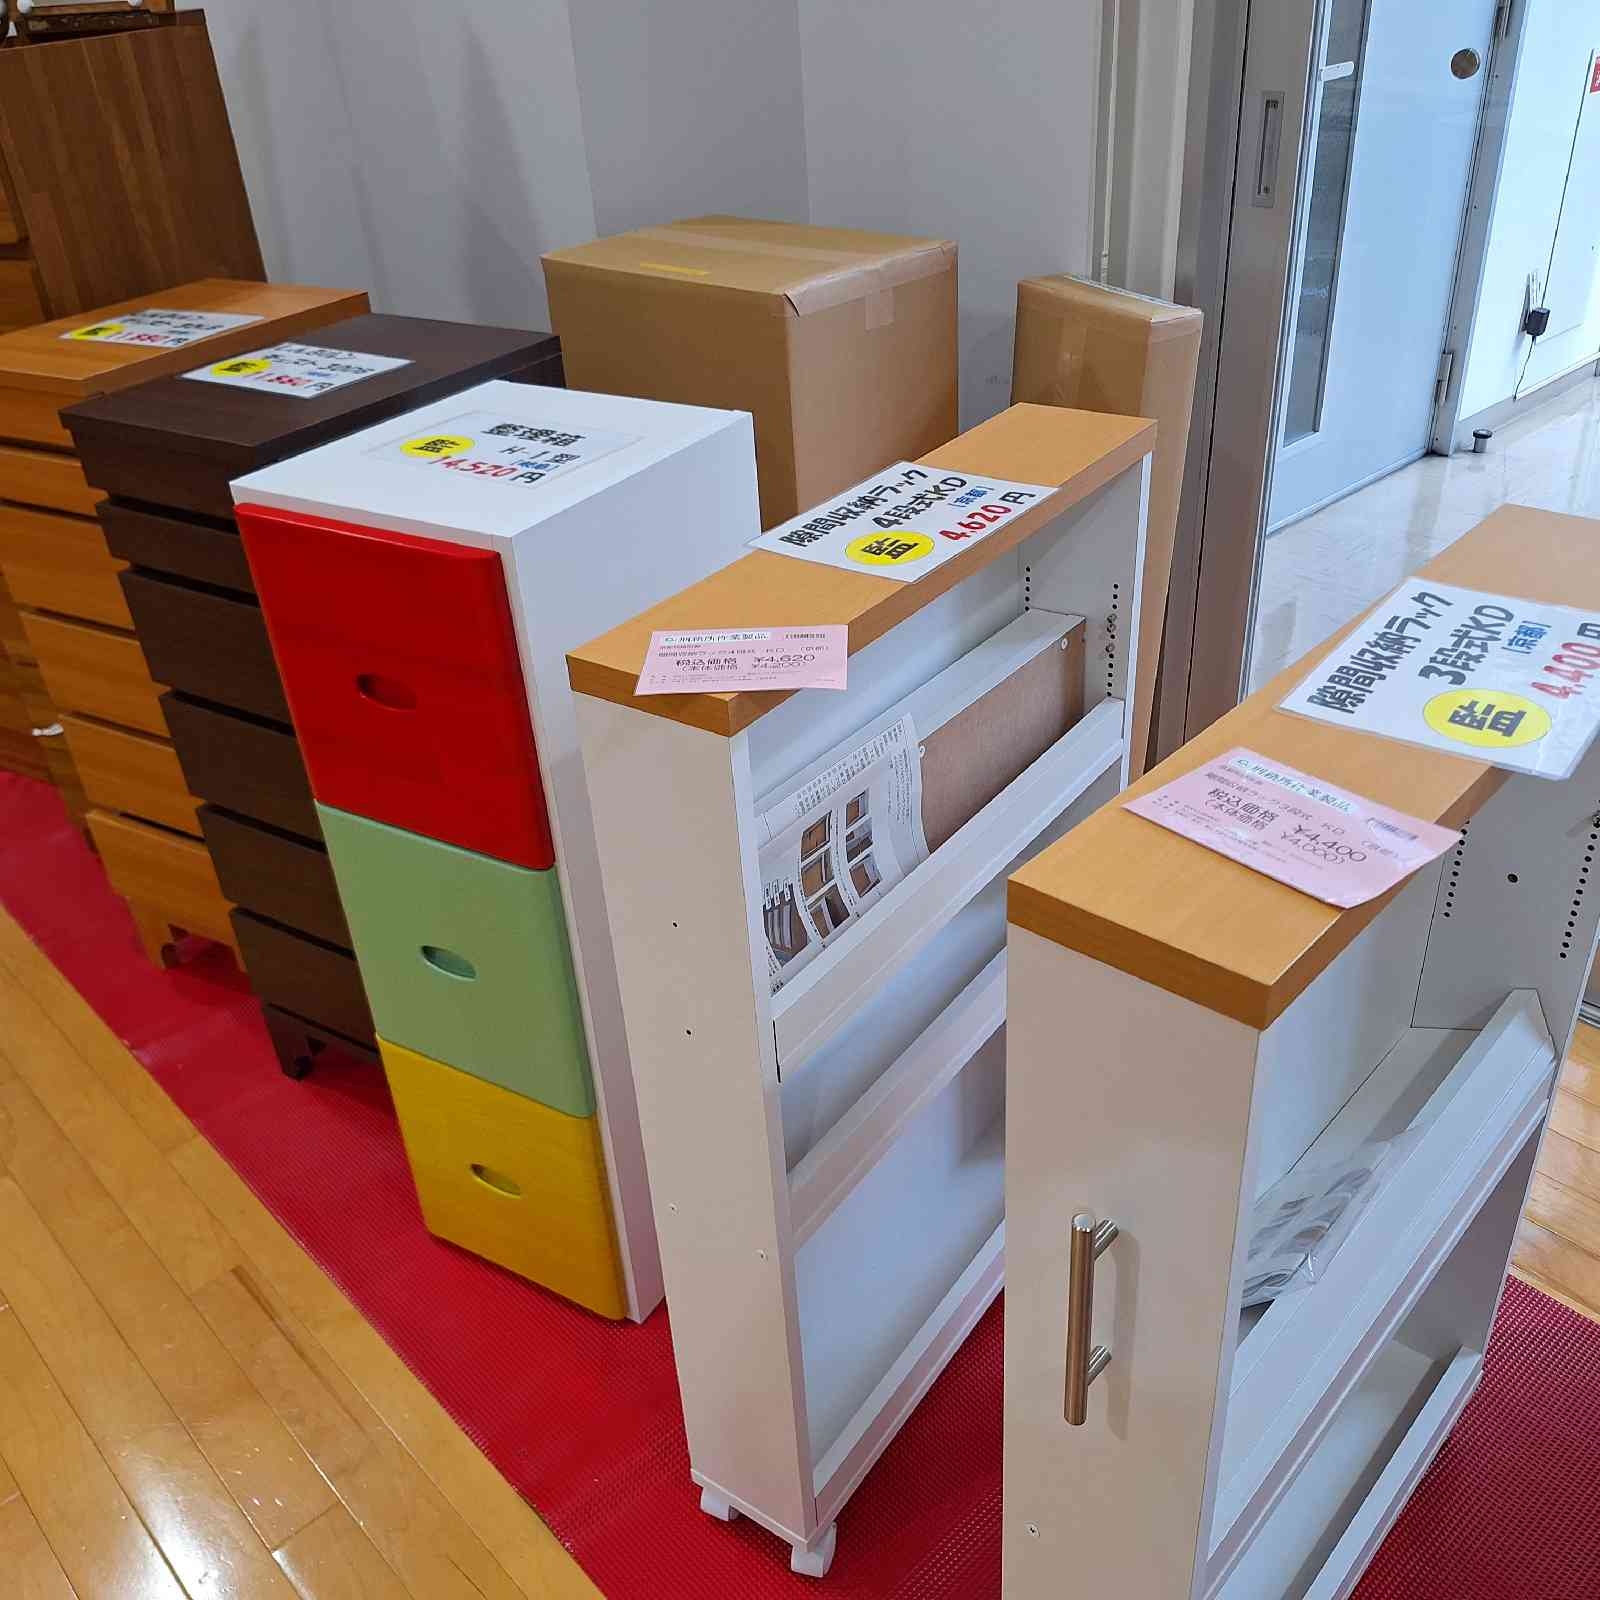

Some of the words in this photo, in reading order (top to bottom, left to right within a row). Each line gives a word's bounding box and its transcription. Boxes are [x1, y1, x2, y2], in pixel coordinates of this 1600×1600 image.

[778, 469, 929, 548] 隙間収納ラック
[860, 536, 920, 560] 監
[1306, 591, 1454, 715] 隙間収納ラック
[1448, 699, 1529, 738] 監
[1208, 788, 1279, 824] 税込価格
[1294, 824, 1367, 863] ¥4,400
